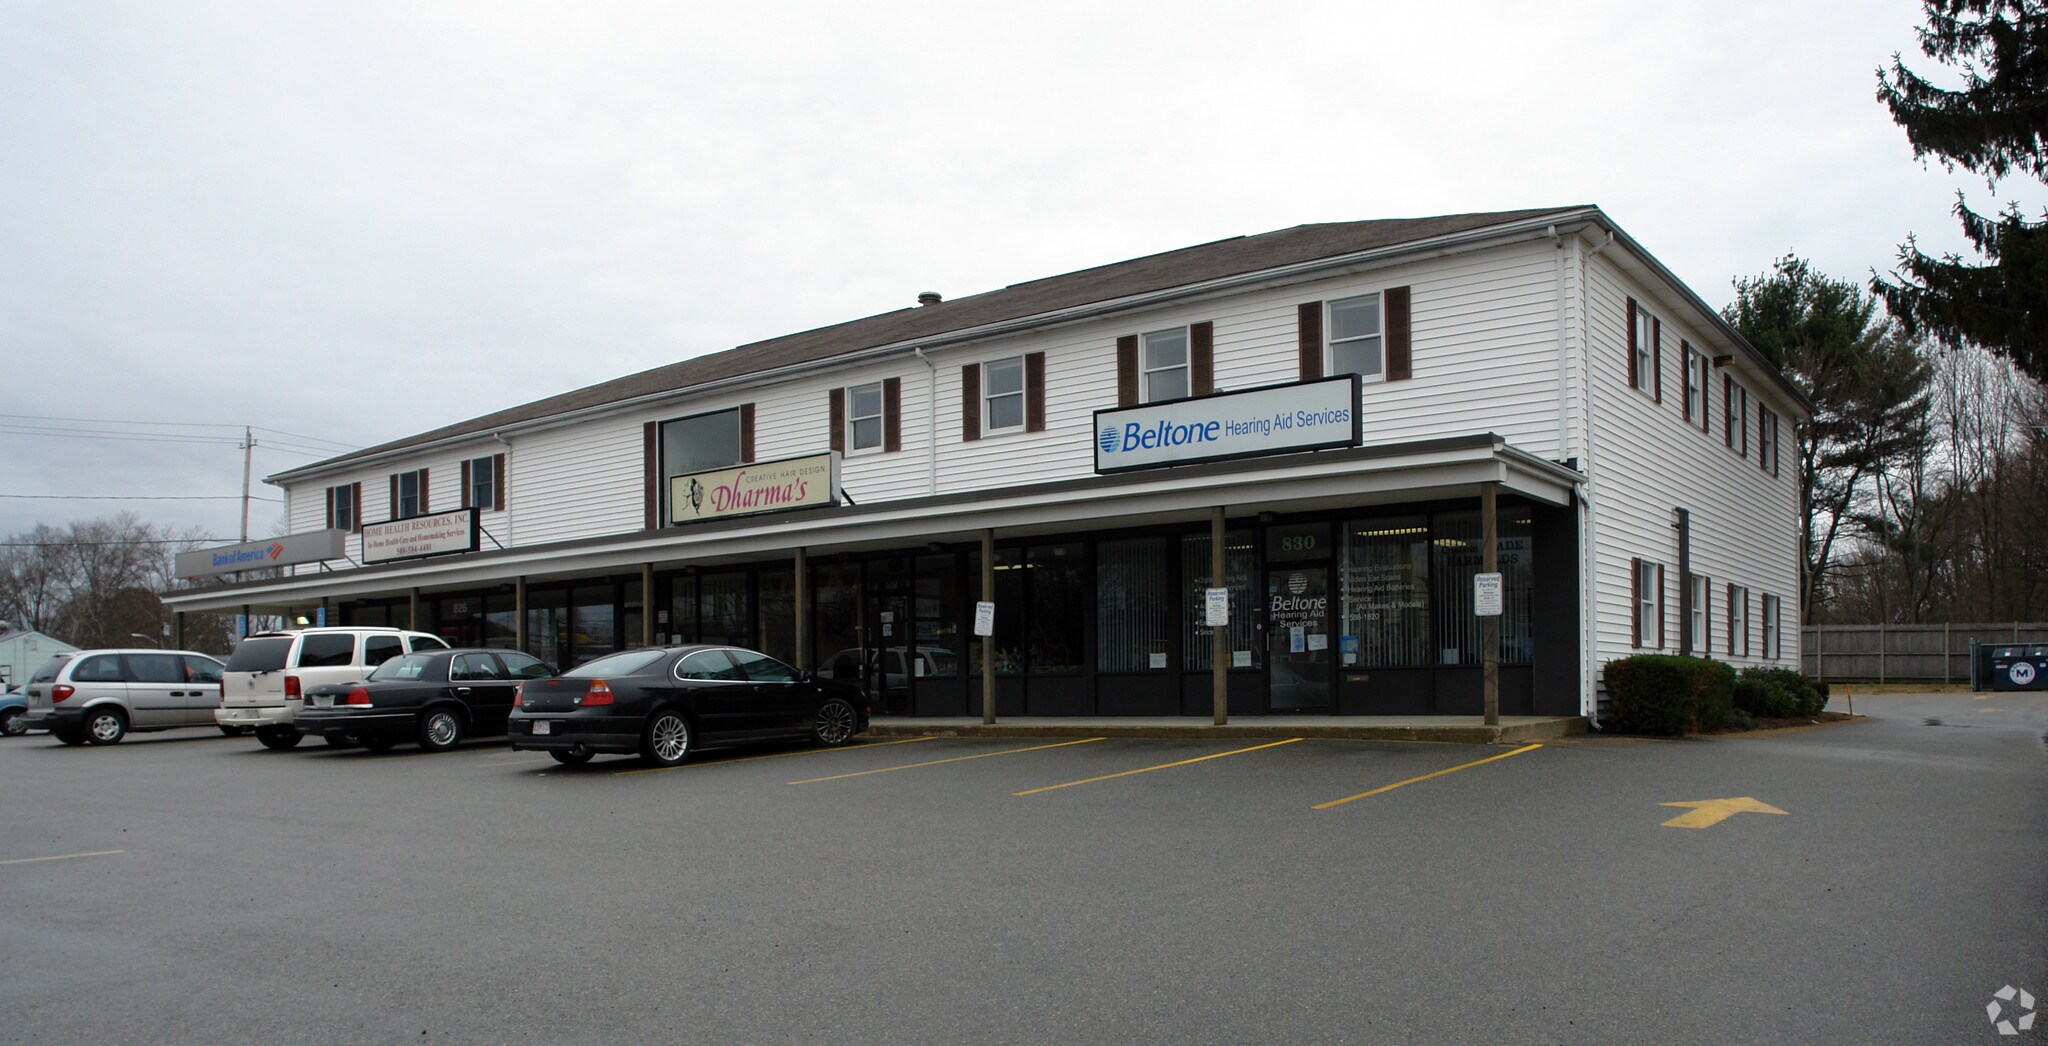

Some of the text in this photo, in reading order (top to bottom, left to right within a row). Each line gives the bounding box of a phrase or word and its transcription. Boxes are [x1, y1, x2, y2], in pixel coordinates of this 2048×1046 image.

[1121, 407, 1349, 452] Beltone Hearing Aid Services
[745, 465, 826, 483] CREATIVE HAIR DESIGN
[710, 471, 808, 512] Dharma's
[364, 513, 470, 538] HOME HEALTH RESOURCES, INC.
[1281, 535, 1316, 552] 830
[1496, 540, 1524, 551] ADE
[212, 549, 264, 566] Bank of America
[1271, 596, 1327, 612] Beltone
[1273, 610, 1325, 621] Hearing Aid
[1279, 620, 1318, 629] Services
[2016, 669, 2028, 678] M
